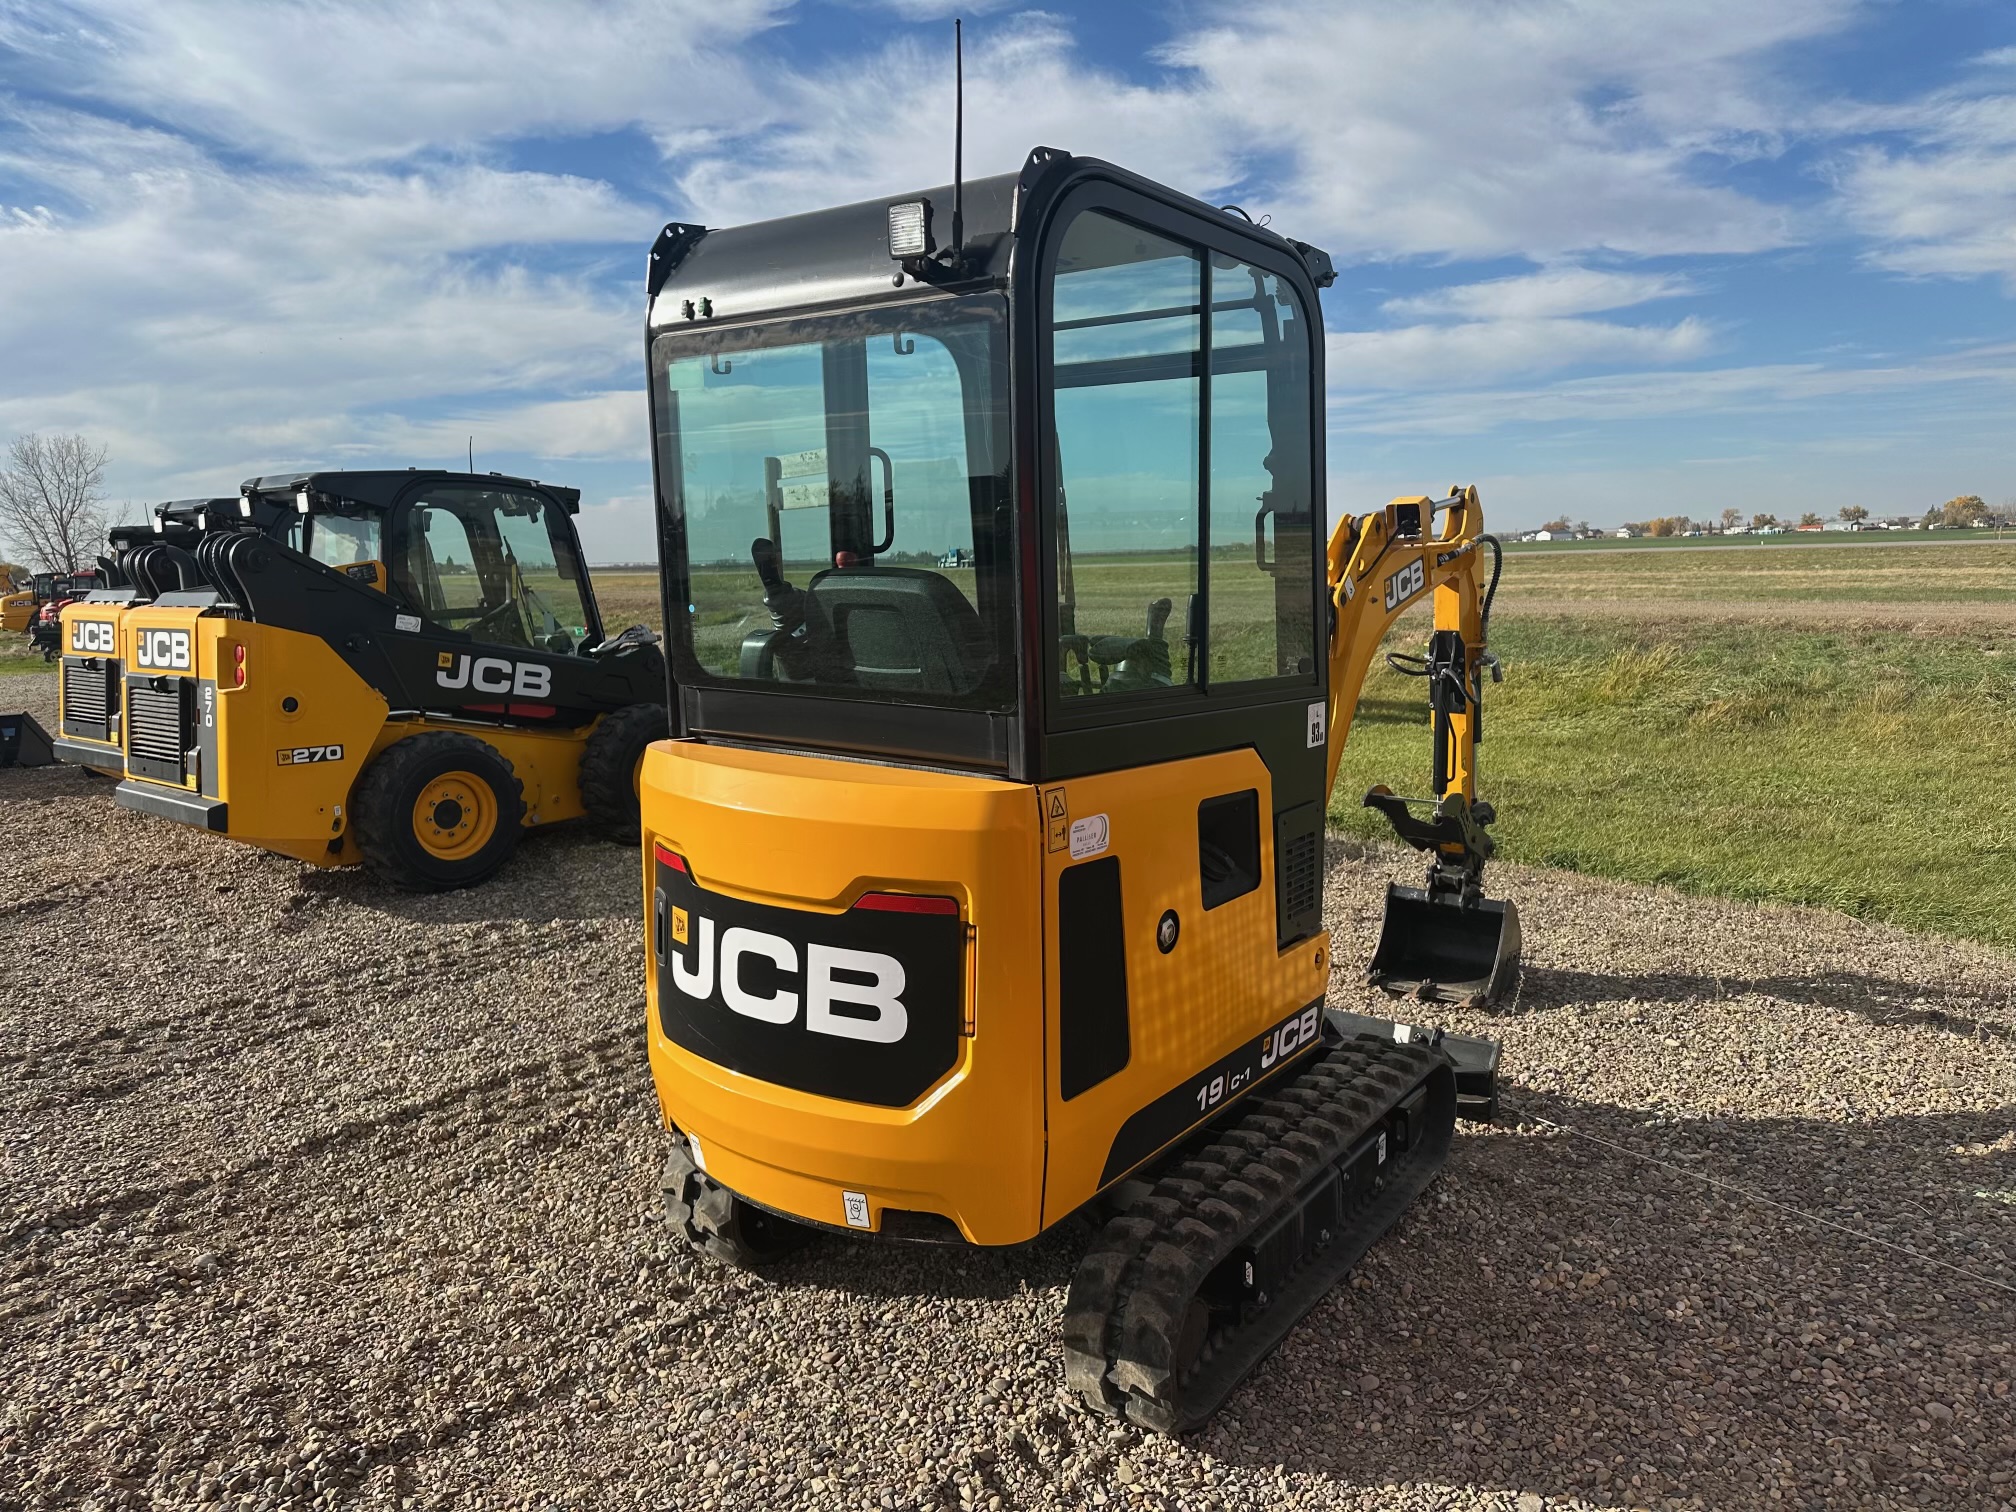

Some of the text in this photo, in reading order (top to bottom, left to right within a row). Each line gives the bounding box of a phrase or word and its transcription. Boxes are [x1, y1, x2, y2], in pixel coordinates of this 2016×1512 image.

[1385, 559, 1425, 609] JCB
[72, 622, 115, 652] JCB
[137, 631, 190, 668] JCB
[436, 654, 552, 698] JCB
[204, 686, 213, 728] 270
[292, 745, 342, 764] 270
[671, 915, 909, 1044] JCB
[1261, 1006, 1318, 1069] JCB
